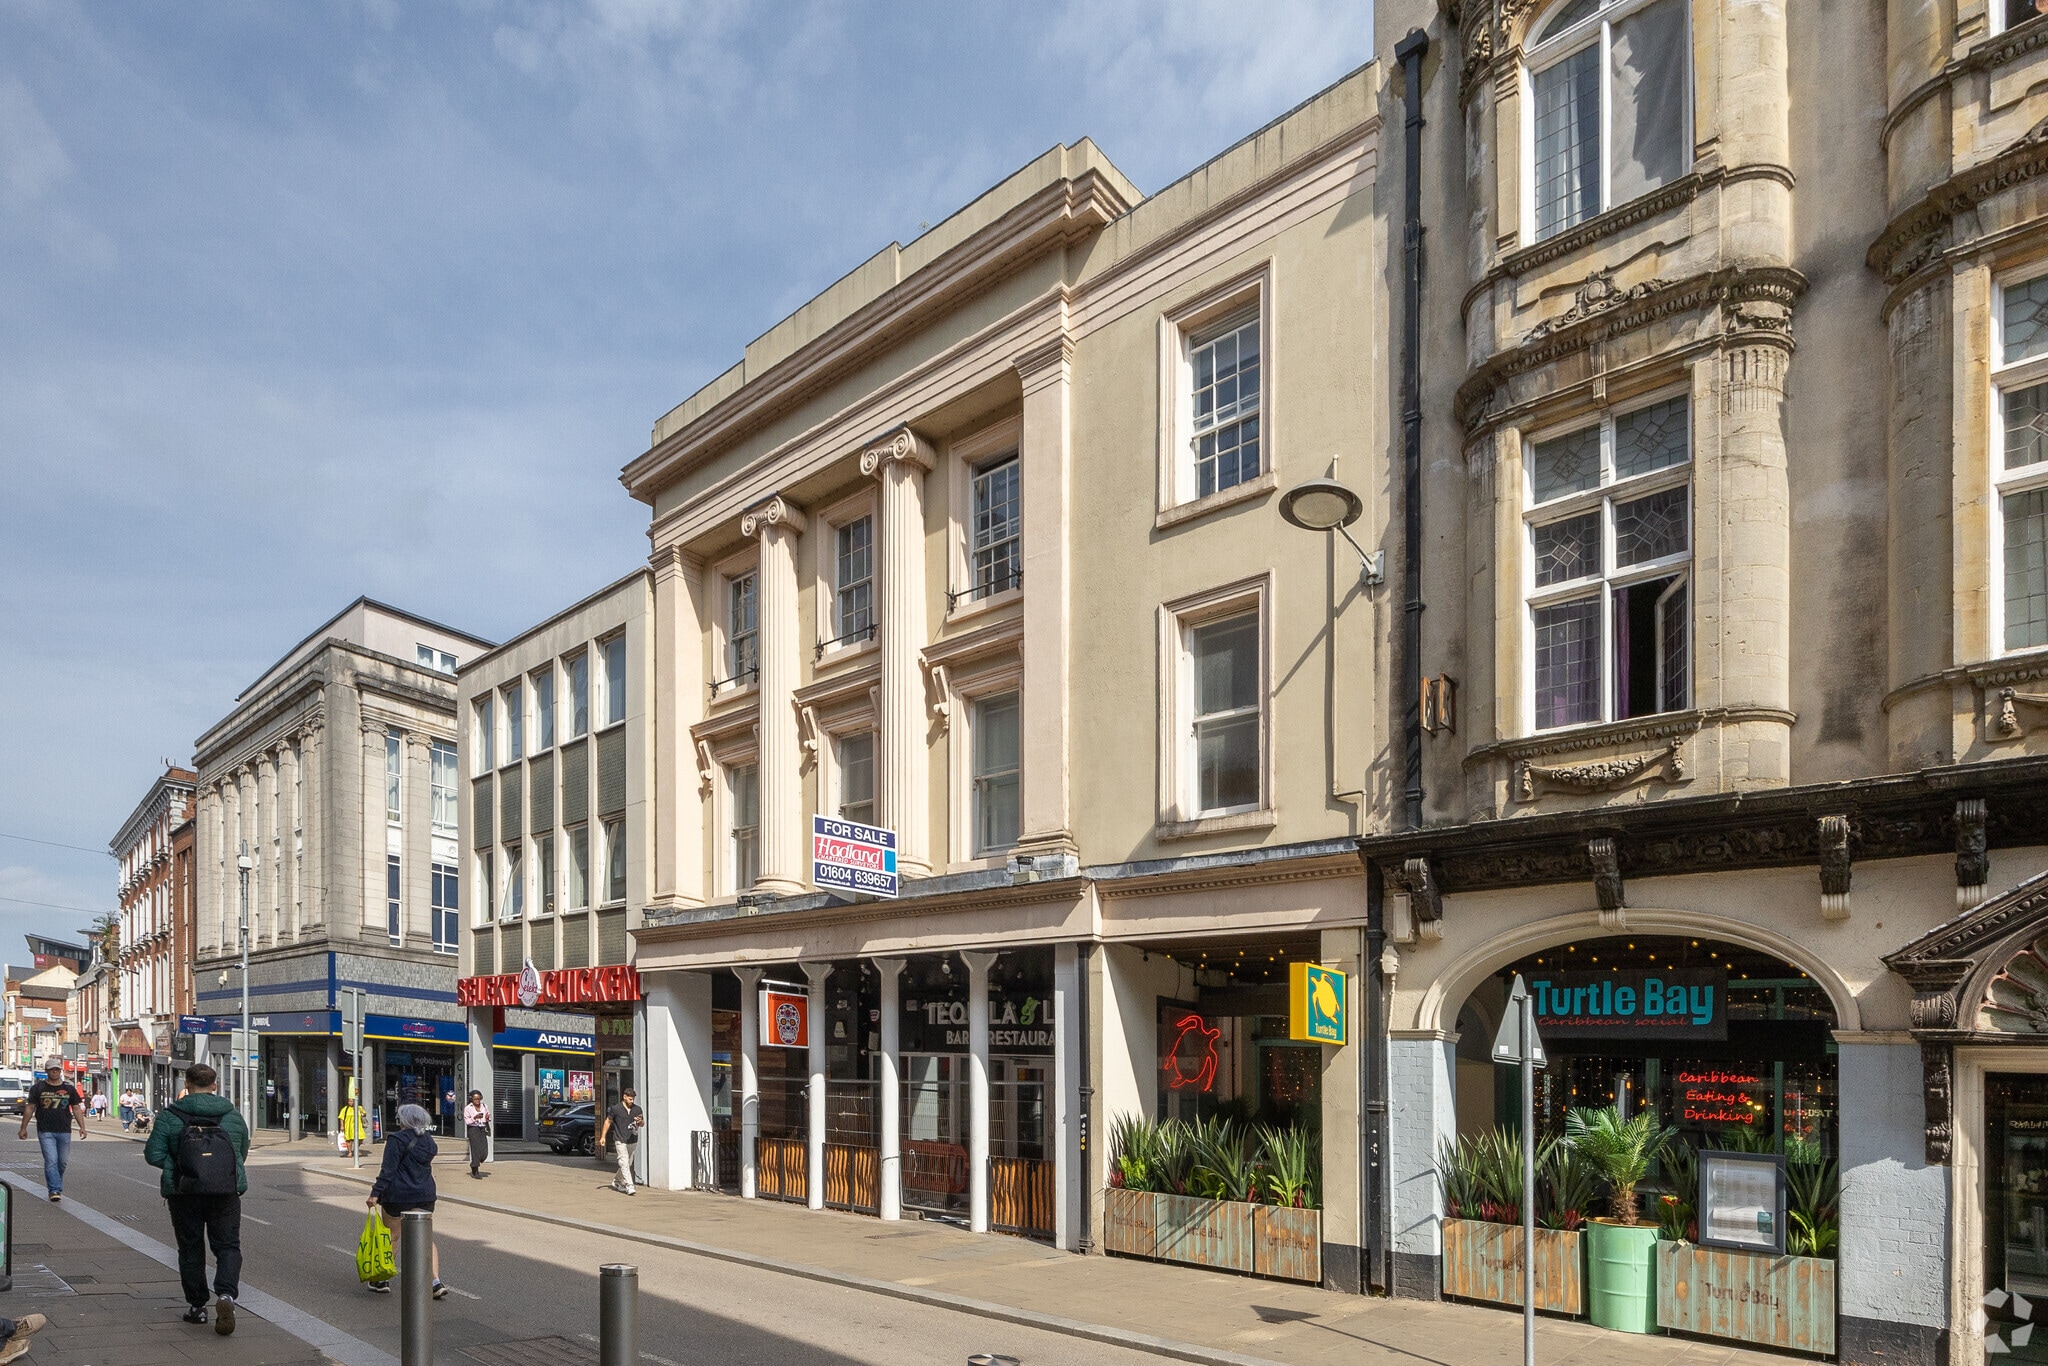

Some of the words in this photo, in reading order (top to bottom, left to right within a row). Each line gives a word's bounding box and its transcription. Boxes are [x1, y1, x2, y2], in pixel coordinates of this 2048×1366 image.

[824, 821, 851, 837] FOR
[854, 827, 888, 845] SALE
[818, 838, 882, 864] Hadland
[818, 855, 848, 863] CHARTERED
[850, 860, 880, 869] SURVEYORS
[820, 865, 852, 881] 01604
[855, 871, 892, 888] 639657
[458, 974, 519, 1006] SELEKT
[517, 967, 538, 997] Selekt
[543, 967, 639, 1002] CHICKEN
[1533, 979, 1636, 1016] Turtle
[1644, 978, 1714, 1026] Bay
[928, 1001, 1019, 1024] TEQLA
[1538, 1016, 1630, 1027] Caribbean
[1634, 1017, 1689, 1027] social
[402, 1023, 435, 1033] CASINO
[946, 1031, 970, 1044] BAR
[1315, 1023, 1328, 1035] Turtle
[1328, 1025, 1336, 1040] Bay
[537, 1033, 593, 1048] ADMIRAL
[1679, 1070, 1758, 1084] Caribbean
[1686, 1089, 1735, 1106] Eating
[1738, 1092, 1752, 1104] &
[1684, 1109, 1754, 1125] Drinking
[1752, 1289, 1779, 1310] Bay
